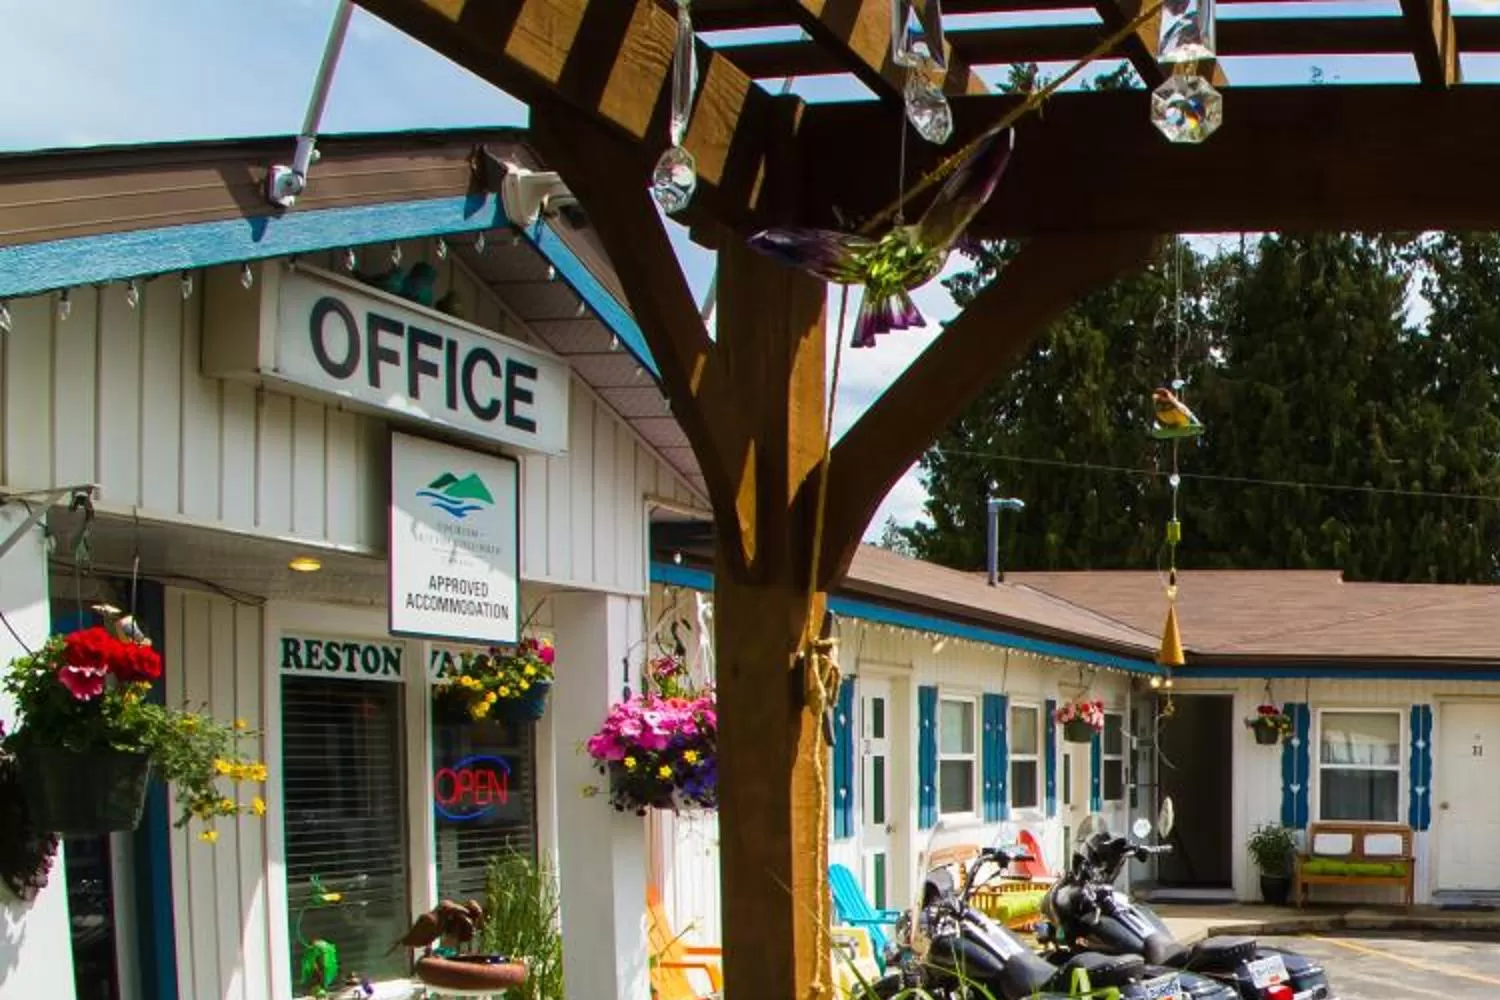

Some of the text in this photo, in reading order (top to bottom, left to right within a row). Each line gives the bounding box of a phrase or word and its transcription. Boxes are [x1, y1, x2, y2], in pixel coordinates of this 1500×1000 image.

[309, 296, 538, 434] OFFICE
[429, 575, 489, 598] APPROVED
[405, 592, 510, 620] ACCOMMODATION
[434, 767, 509, 805] OPEN
